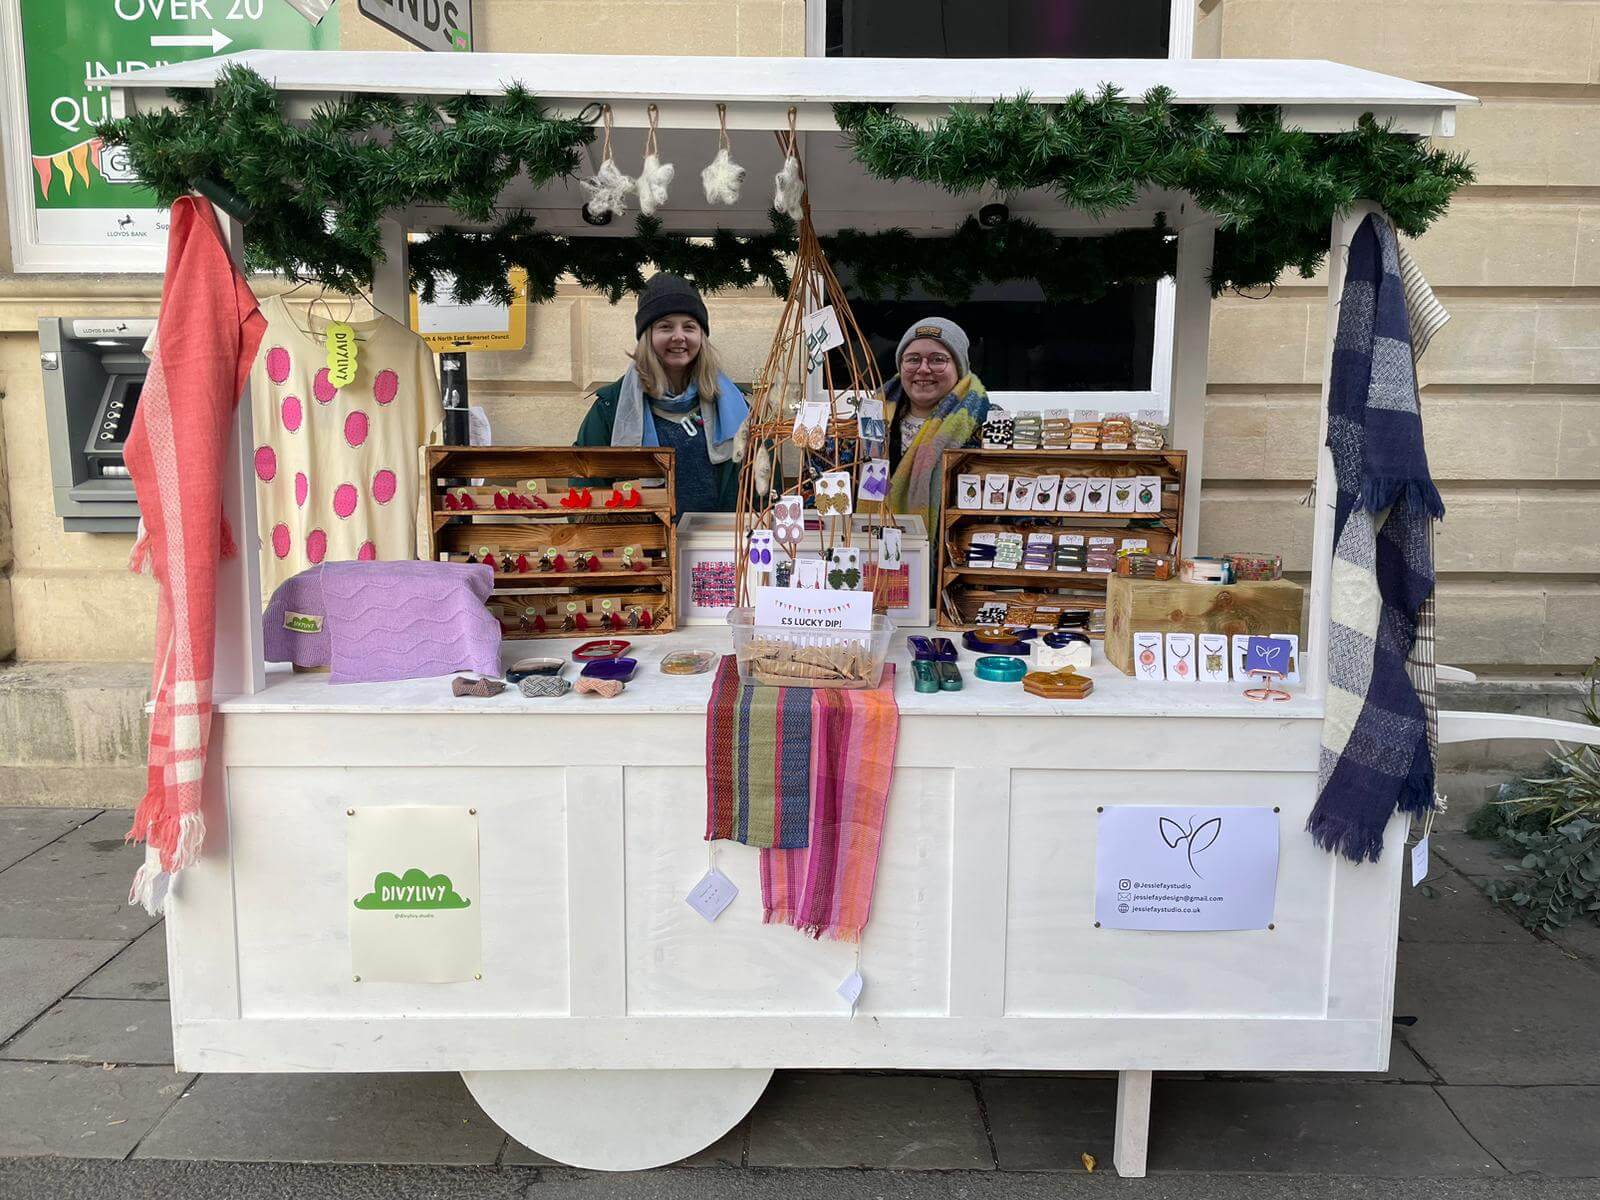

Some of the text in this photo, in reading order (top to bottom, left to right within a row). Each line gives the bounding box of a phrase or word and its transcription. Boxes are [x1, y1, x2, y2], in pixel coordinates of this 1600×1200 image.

[114, 0, 264, 21] OVER 20
[781, 617, 842, 628] £5 LUCKY DIP!
[1133, 882, 1192, 890] @Jessiefaystudio
[381, 885, 446, 903] DIVYLIVY
[1133, 894, 1224, 902] jessiefaydesign@gmail.com
